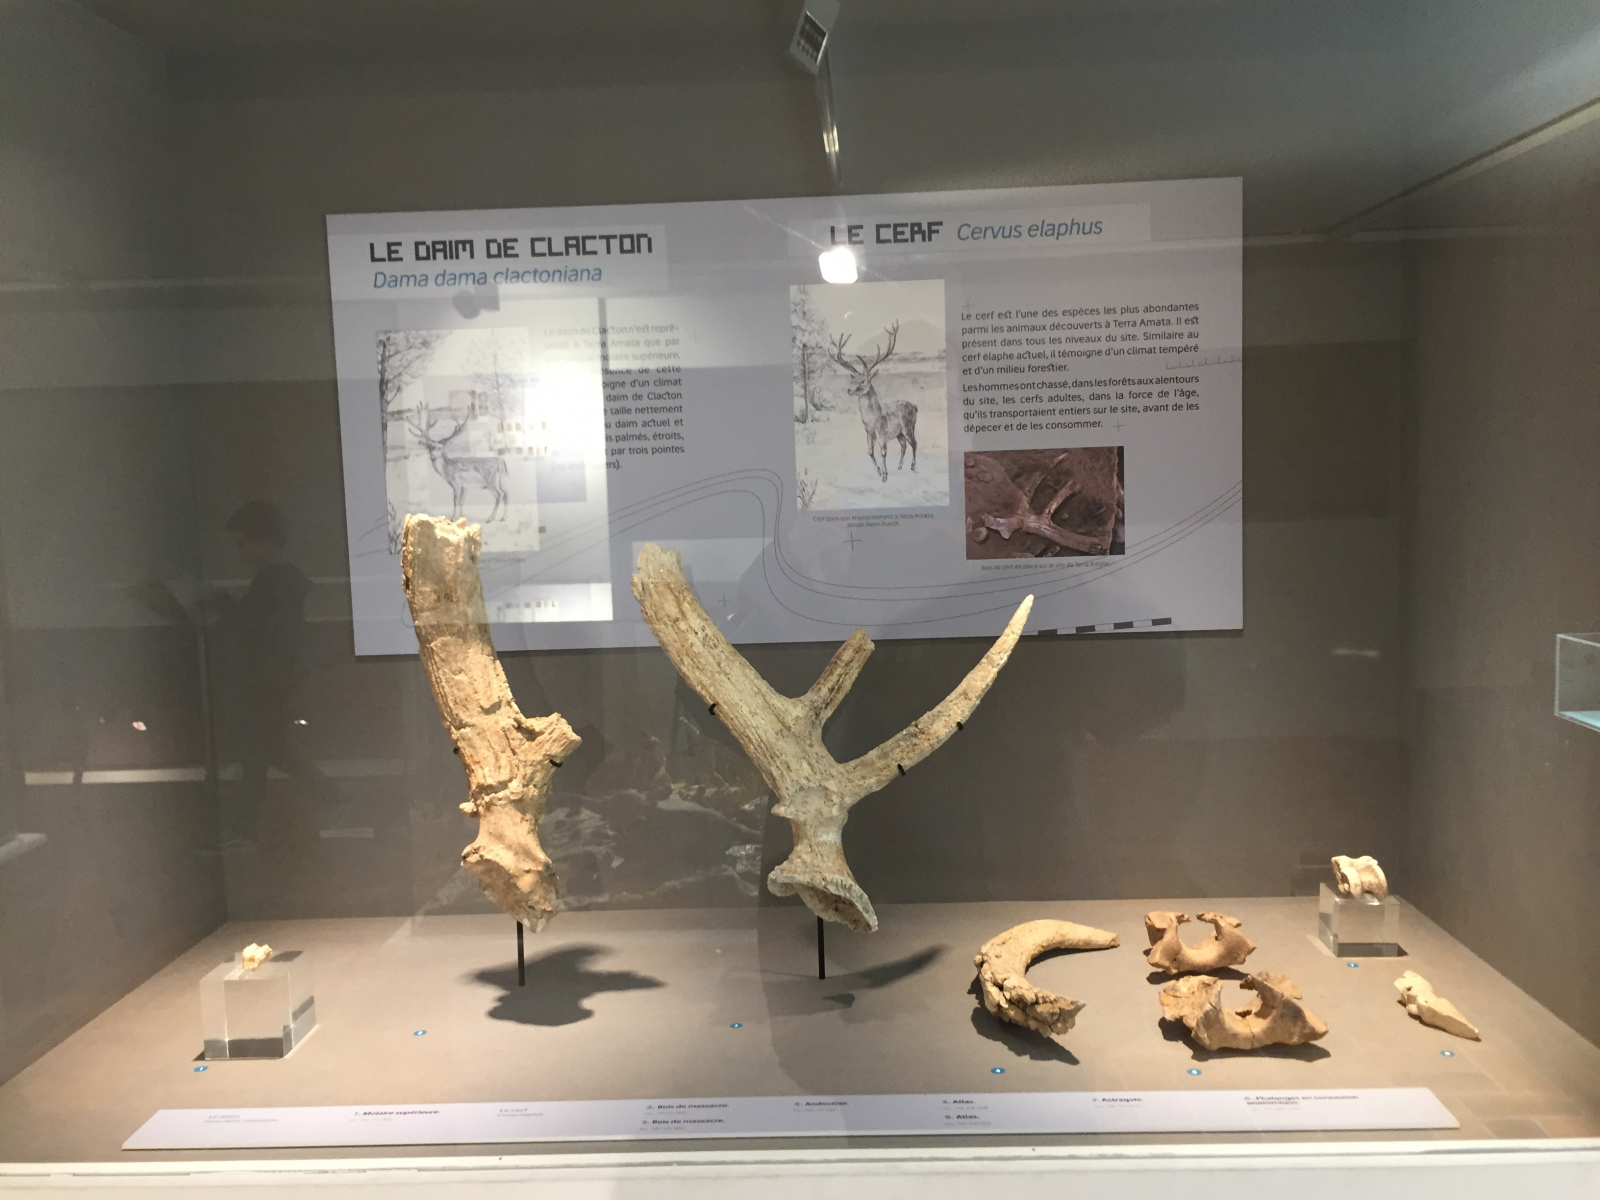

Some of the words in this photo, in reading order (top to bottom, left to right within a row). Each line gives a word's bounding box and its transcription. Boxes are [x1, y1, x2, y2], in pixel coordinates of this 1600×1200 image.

[830, 225, 864, 245] LE
[875, 221, 944, 244] CERF
[957, 223, 1022, 242] Cervus
[1027, 218, 1103, 242] elaphus
[369, 241, 403, 262] LE
[414, 239, 475, 261] DAIM
[486, 237, 519, 259] DE
[530, 232, 653, 258] CLACTON
[373, 271, 429, 289] Dama
[434, 269, 487, 287] dama
[493, 266, 602, 284] clactoniana
[961, 312, 972, 321] Le
[975, 311, 994, 320] cerf
[998, 310, 1012, 319] est
[1015, 309, 1038, 318] l'une
[1041, 308, 1058, 317] des
[1062, 307, 1100, 318] espèces
[1103, 306, 1117, 315] les
[1120, 305, 1140, 316] plus
[1143, 303, 1199, 313] abondantes
[556, 327, 578, 336] daim
[579, 327, 591, 336] de
[592, 325, 628, 335] Clacton
[629, 324, 650, 334] n'est
[651, 324, 679, 334] repré-
[961, 326, 988, 336] parmi
[991, 325, 1004, 333] les
[1006, 324, 1047, 333] animaux
[1049, 321, 1102, 331] découverts
[1105, 320, 1111, 329] à
[1114, 319, 1137, 328] Terra
[1139, 318, 1173, 327] Amata.
[1176, 317, 1182, 325] Il
[1184, 316, 1199, 325] est
[584, 340, 608, 349] Terra
[610, 339, 640, 348] Amata
[644, 339, 661, 349] que
[665, 338, 681, 348] par
[961, 339, 997, 350] présent
[1000, 338, 1022, 346] dans
[1026, 337, 1046, 346] tous
[1049, 336, 1062, 345] les
[1065, 335, 1102, 344] niveaux
[1105, 334, 1117, 342] du
[1120, 333, 1140, 342] site.
[1143, 331, 1184, 341] Similaire
[1187, 331, 1199, 339] au
[632, 352, 680, 363] supérieure.
[962, 352, 980, 362] cerf
[983, 351, 1014, 362] élaphe
[1016, 350, 1048, 360] actuel,
[1050, 350, 1056, 358] il
[1057, 348, 1102, 359] témoigne
[1105, 348, 1125, 356] d'un
[1127, 346, 1156, 355] climat
[1159, 343, 1199, 355] tempéré
[962, 368, 972, 376] et
[974, 366, 994, 375] d'un
[996, 364, 1025, 374] milieu
[1028, 363, 1069, 373] forestier.
[630, 378, 649, 388] d'un
[653, 377, 682, 387] climat
[962, 384, 978, 392] Les
[978, 383, 1019, 391] hommes
[1020, 381, 1036, 390] ont
[1037, 380, 1071, 390] chassé,
[1072, 379, 1094, 388] dans
[1095, 378, 1107, 387] les
[1108, 377, 1136, 386] forêts
[1155, 375, 1199, 385] alentours
[606, 392, 628, 402] daim
[632, 392, 643, 401] de
[647, 391, 682, 401] Clacton
[962, 397, 975, 406] du
[979, 396, 999, 406] site,
[1002, 395, 1016, 404] les
[1020, 394, 1043, 403] cerfs
[1047, 393, 1085, 402] adultes,
[1089, 392, 1111, 401] dans
[1115, 391, 1124, 400] la
[1128, 390, 1153, 399] force
[1157, 389, 1170, 398] de
[1174, 388, 1199, 399] l'âge,
[610, 406, 632, 415] taille
[634, 405, 683, 414] nettement
[963, 410, 987, 420] qu'ils
[989, 408, 1056, 419] transportaient
[1059, 406, 1091, 415] entiers
[1110, 405, 1118, 413] le
[1120, 405, 1140, 414] site,
[1143, 404, 1169, 413] avant
[1171, 403, 1183, 411] de
[1186, 402, 1199, 411] les
[615, 419, 637, 428] daim
[641, 418, 670, 428] actuel
[674, 418, 684, 427] et
[963, 423, 1001, 434] dépecer
[1004, 423, 1014, 431] et
[1016, 422, 1028, 430] de
[1030, 422, 1044, 430] les
[1045, 420, 1103, 430] consommer.
[615, 433, 650, 443] palmés,
[652, 431, 684, 442] étroits,
[611, 447, 625, 457] par
[629, 446, 648, 455] trois
[651, 445, 685, 456] pointes
